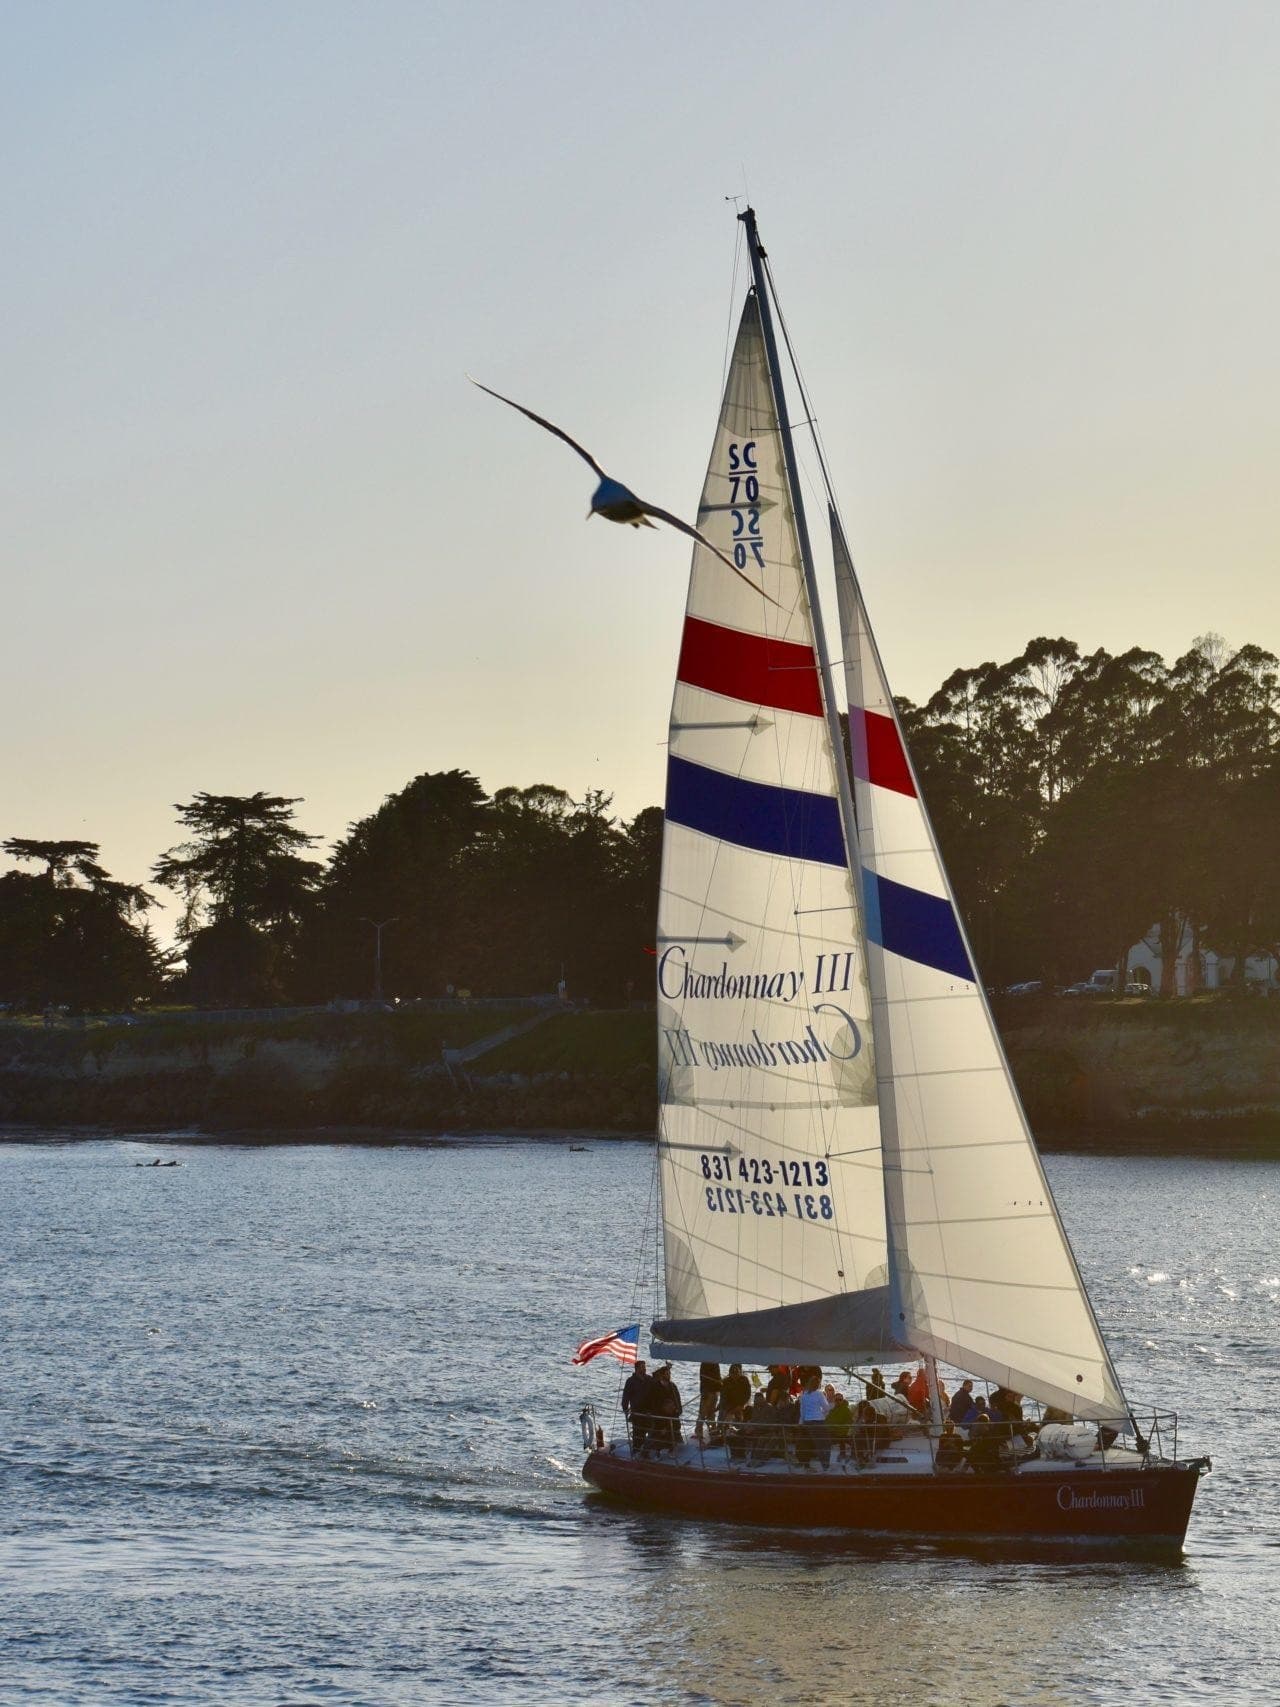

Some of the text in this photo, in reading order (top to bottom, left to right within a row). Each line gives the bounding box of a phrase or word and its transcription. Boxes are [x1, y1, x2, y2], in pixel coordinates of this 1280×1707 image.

[728, 441, 757, 470] SC
[729, 475, 759, 504] 70
[658, 945, 854, 1003] Chardonnay III
[701, 1154, 829, 1187] 831 423-1213
